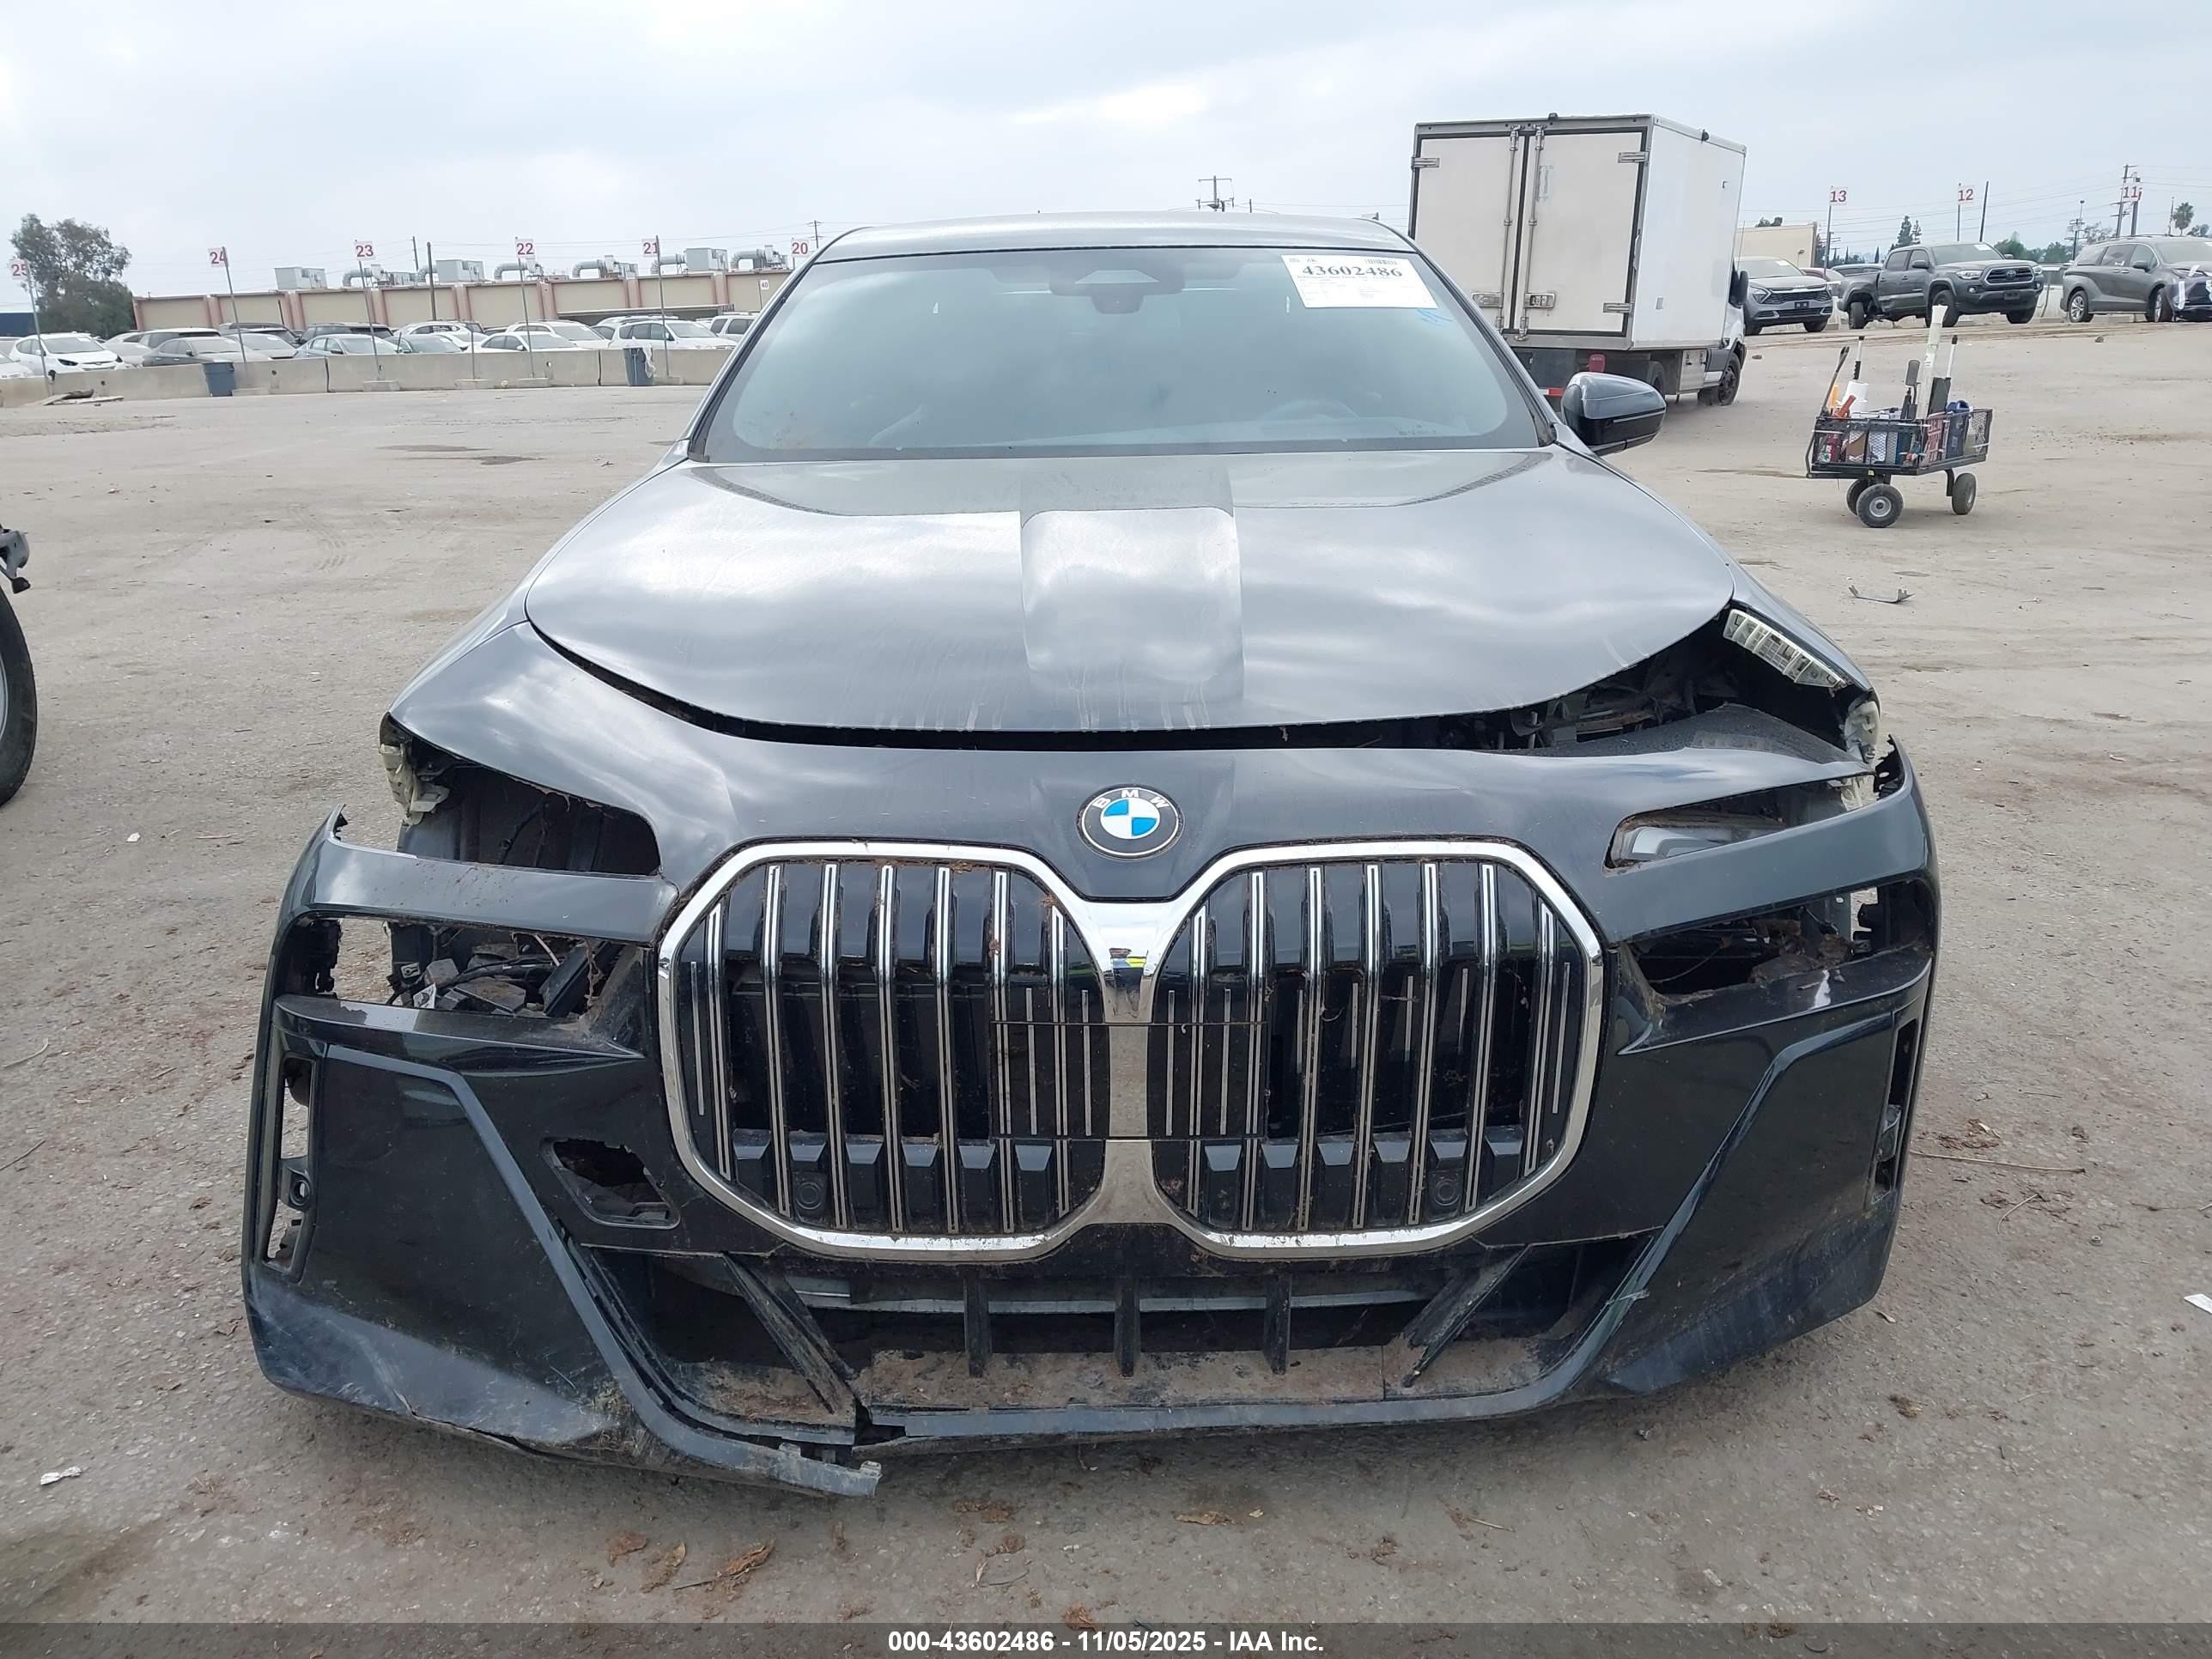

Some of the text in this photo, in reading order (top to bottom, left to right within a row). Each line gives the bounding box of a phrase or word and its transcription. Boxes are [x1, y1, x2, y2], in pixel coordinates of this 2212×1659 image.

[1830, 190, 1846, 203] 13
[1958, 188, 1973, 202] 12
[2123, 185, 2138, 198] 11
[356, 245, 374, 258] 23
[516, 242, 534, 255] 22
[643, 242, 659, 254] 21
[792, 242, 808, 255] 20
[210, 251, 226, 264] 24
[11, 264, 28, 276] 25
[1303, 265, 1403, 277] 43602486
[1091, 789, 1170, 810] BMW
